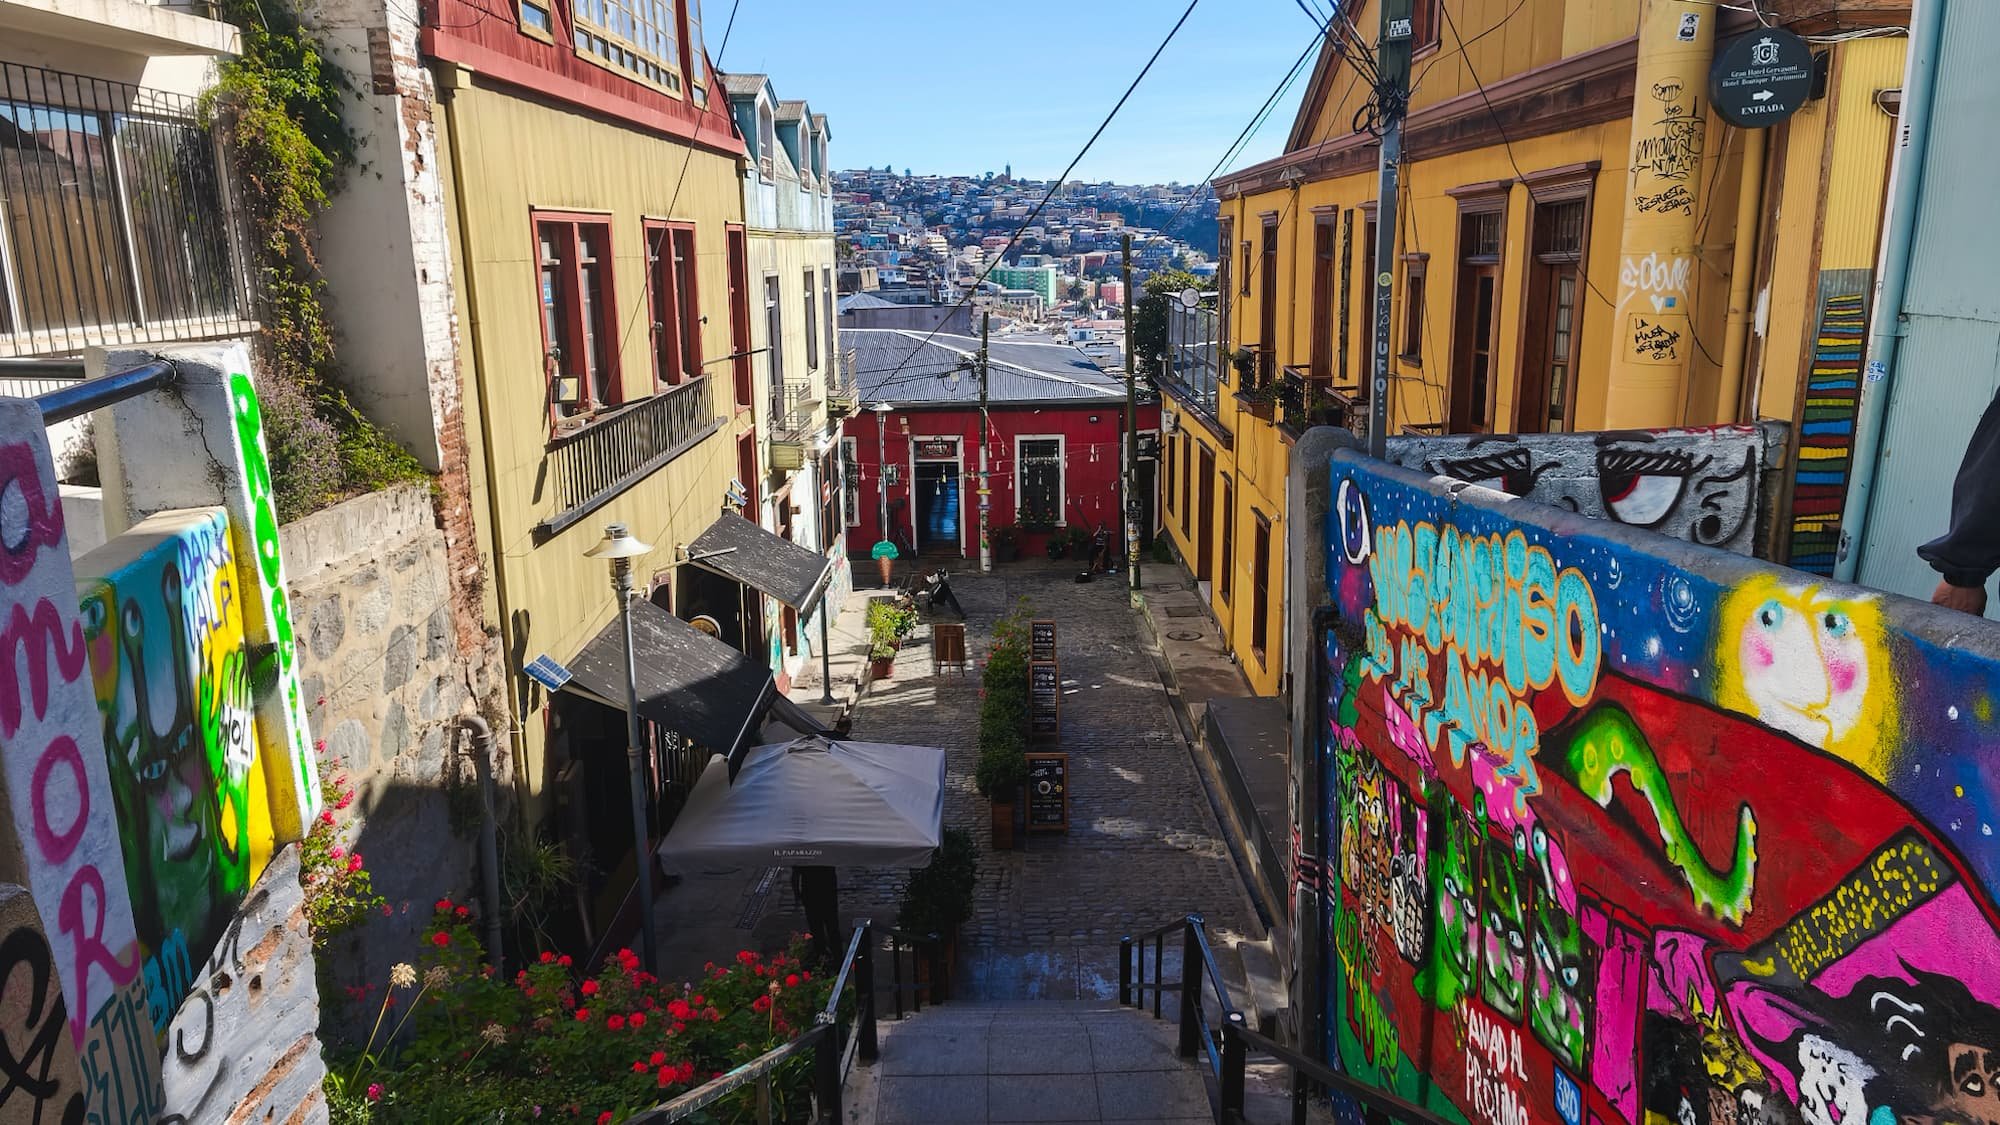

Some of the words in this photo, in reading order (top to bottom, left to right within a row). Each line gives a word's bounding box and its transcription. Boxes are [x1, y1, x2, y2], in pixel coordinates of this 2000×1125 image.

[1731, 70, 1747, 78] Gran
[1748, 67, 1765, 76] Hotel
[1766, 64, 1798, 75] Gervasoni
[1722, 80, 1740, 88] Hotel
[1741, 77, 1769, 86] Boutique
[1741, 104, 1785, 115] ENTRADA
[1424, 641, 1543, 816] AMOR
[1468, 1007, 1507, 1074] AMAD
[1510, 1029, 1529, 1082] AL
